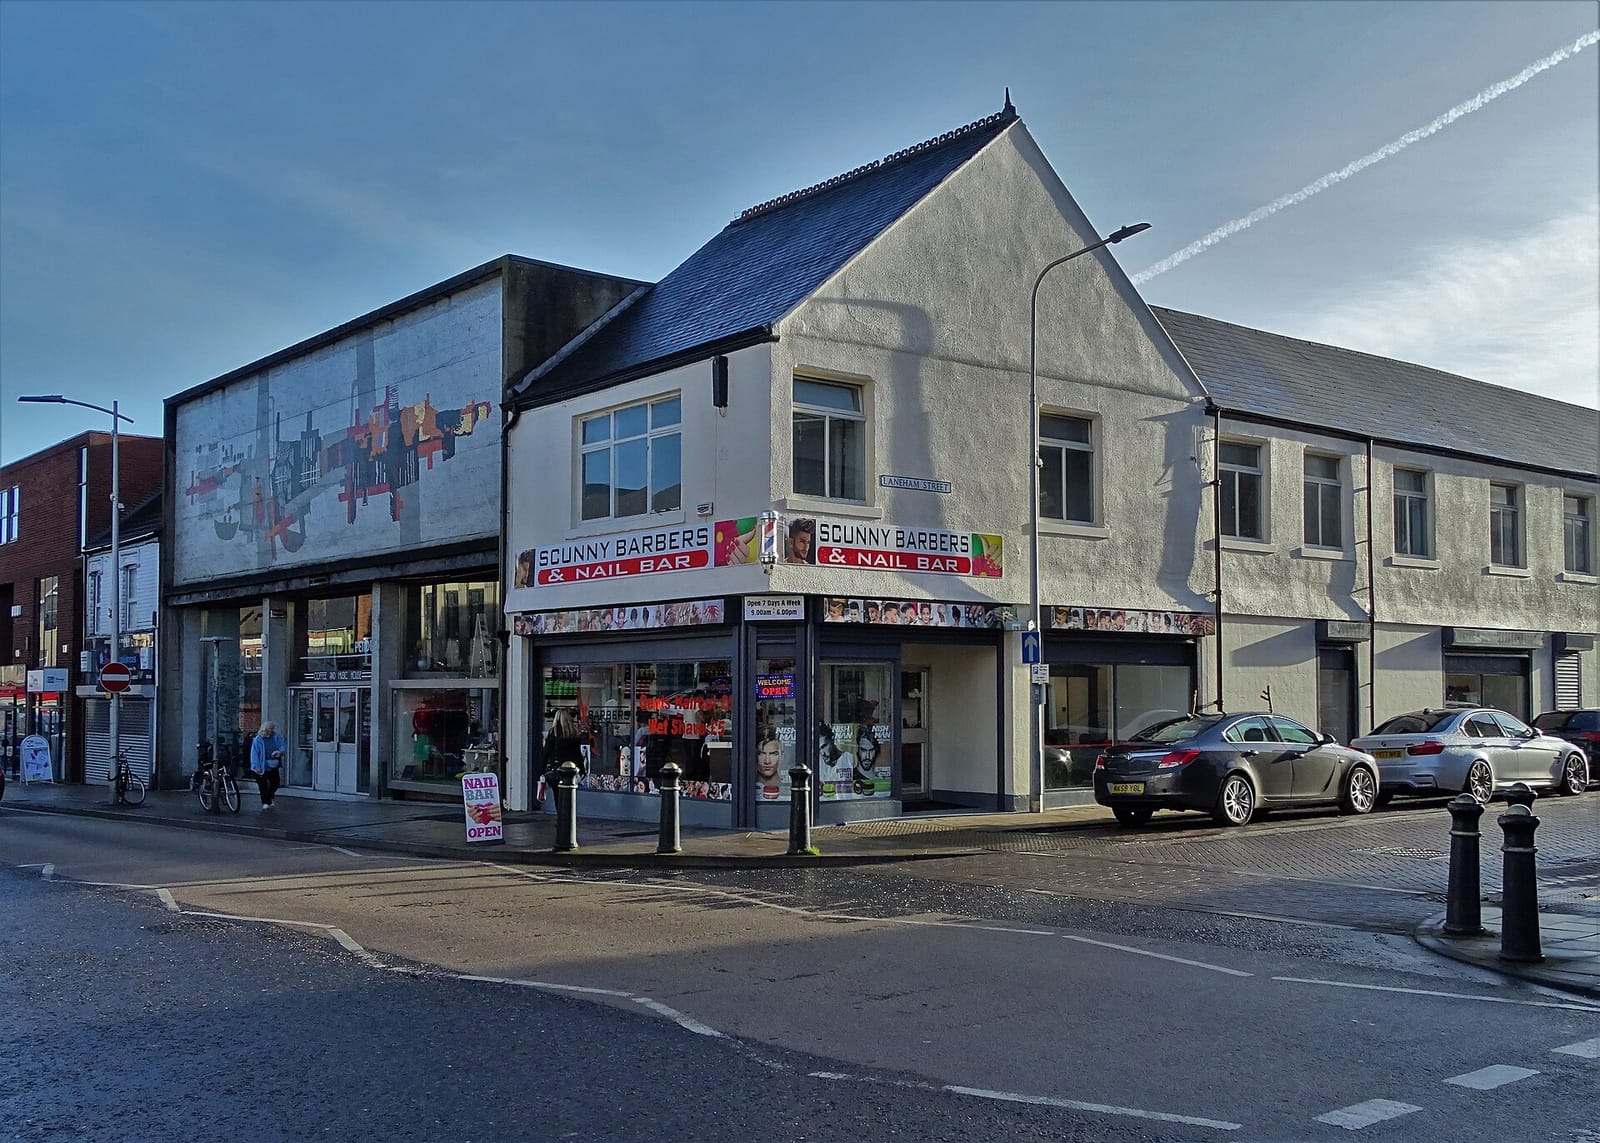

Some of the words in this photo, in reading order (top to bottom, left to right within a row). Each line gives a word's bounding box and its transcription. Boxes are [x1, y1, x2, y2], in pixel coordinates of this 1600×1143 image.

[883, 477, 920, 489] LANEHAM
[923, 481, 949, 491] STREET
[819, 523, 891, 547] SCUNNY
[895, 530, 969, 553] BARBERS
[539, 541, 610, 567] SCUNNY
[616, 527, 709, 557] BARBERS
[828, 548, 846, 564] &
[857, 552, 907, 568] NAIL
[917, 557, 959, 572] BAR
[547, 568, 564, 582] &
[575, 563, 628, 579] NAIL
[639, 555, 691, 573] BAR
[762, 687, 789, 696] OPEN
[588, 710, 631, 721] BARBERS
[648, 718, 668, 735] Wet
[671, 718, 707, 736] Shave
[464, 777, 496, 789] NAIL
[465, 789, 494, 800] BAR
[468, 826, 501, 838] OPEN
